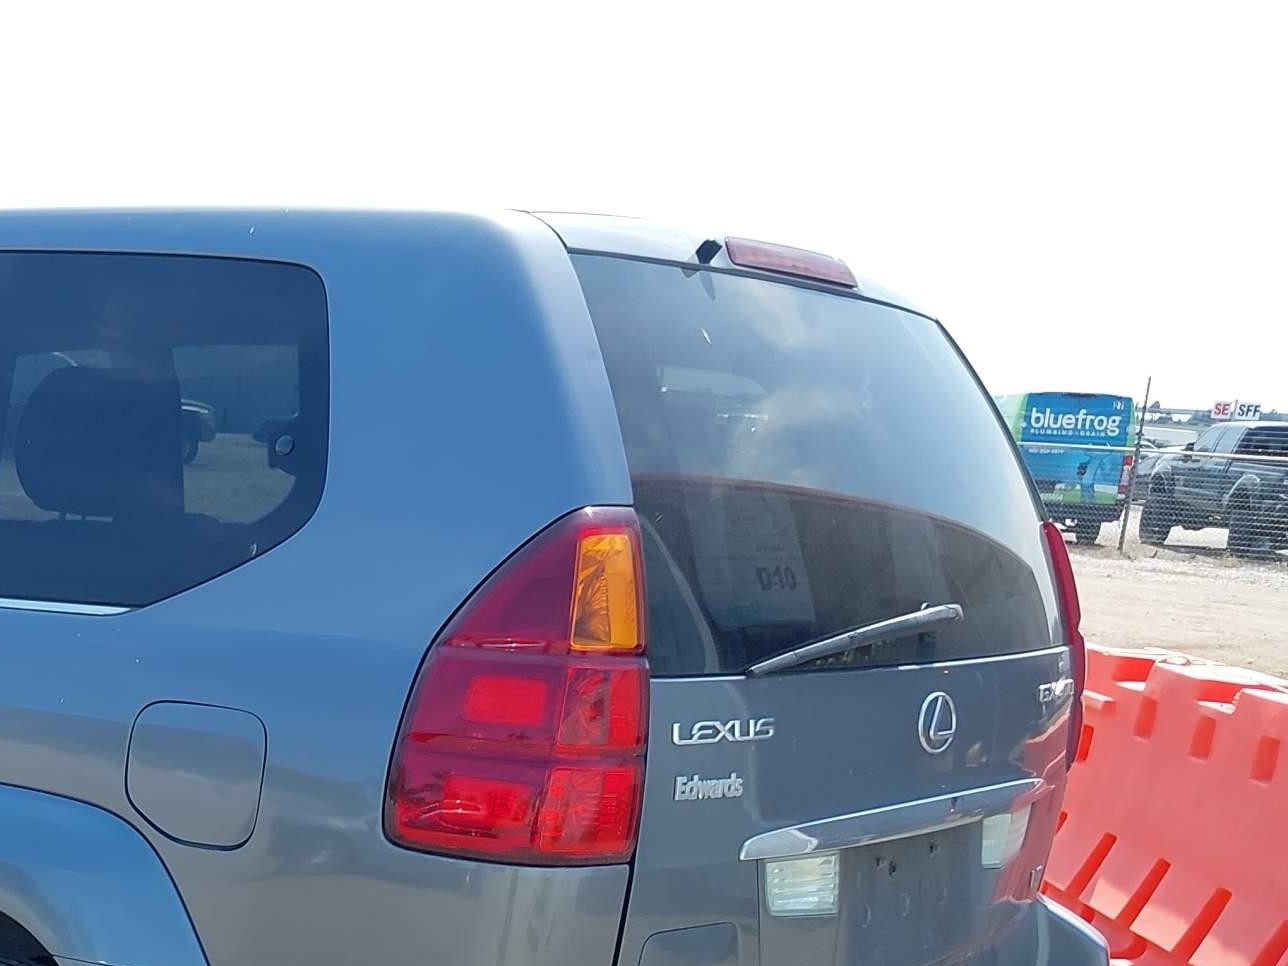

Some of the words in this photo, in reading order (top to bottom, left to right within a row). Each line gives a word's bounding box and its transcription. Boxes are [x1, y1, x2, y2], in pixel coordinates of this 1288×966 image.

[1030, 407, 1122, 436] bluefrog
[672, 717, 775, 746] LEXUS
[674, 771, 744, 801] Edwards
